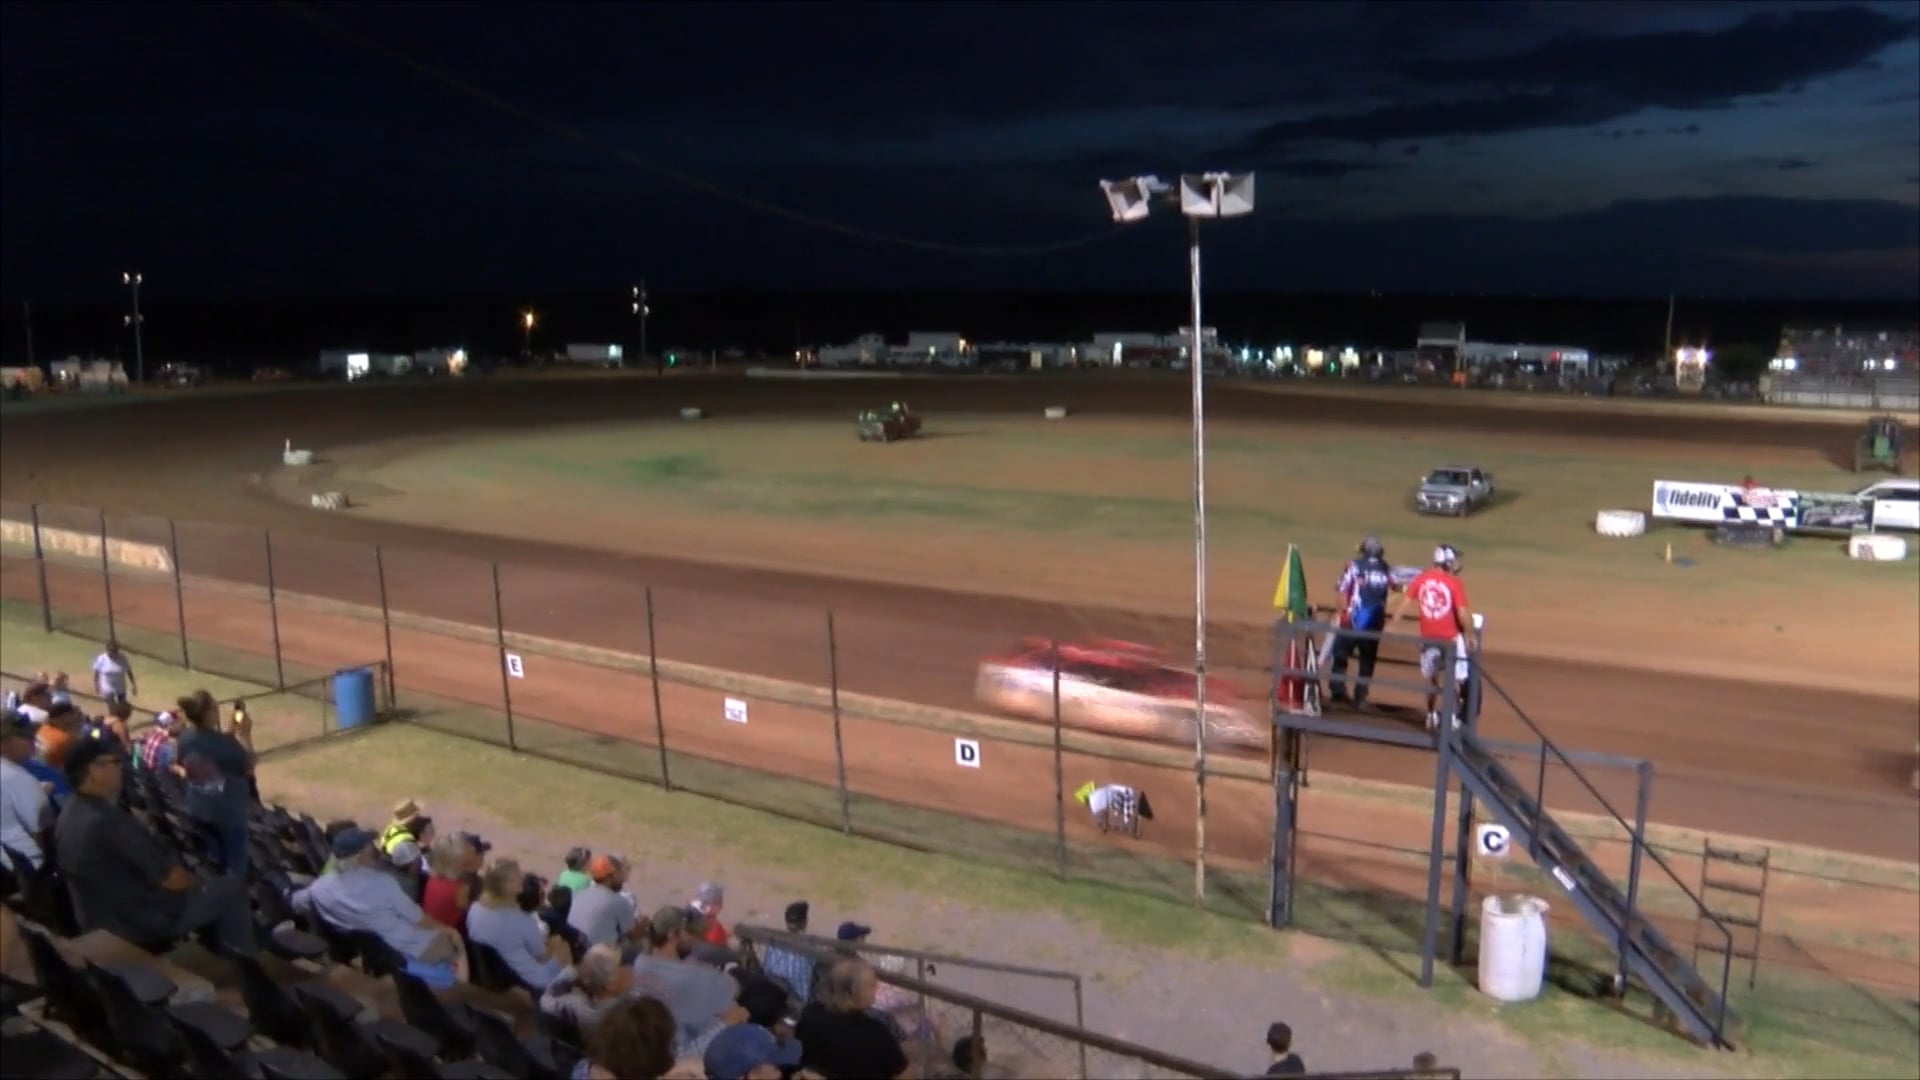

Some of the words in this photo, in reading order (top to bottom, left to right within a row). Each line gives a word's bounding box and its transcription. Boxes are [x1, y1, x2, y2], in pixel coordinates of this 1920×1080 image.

[1669, 488, 1721, 509] fidelity
[510, 658, 520, 673] E
[960, 744, 975, 762] D
[1483, 831, 1504, 852] C
